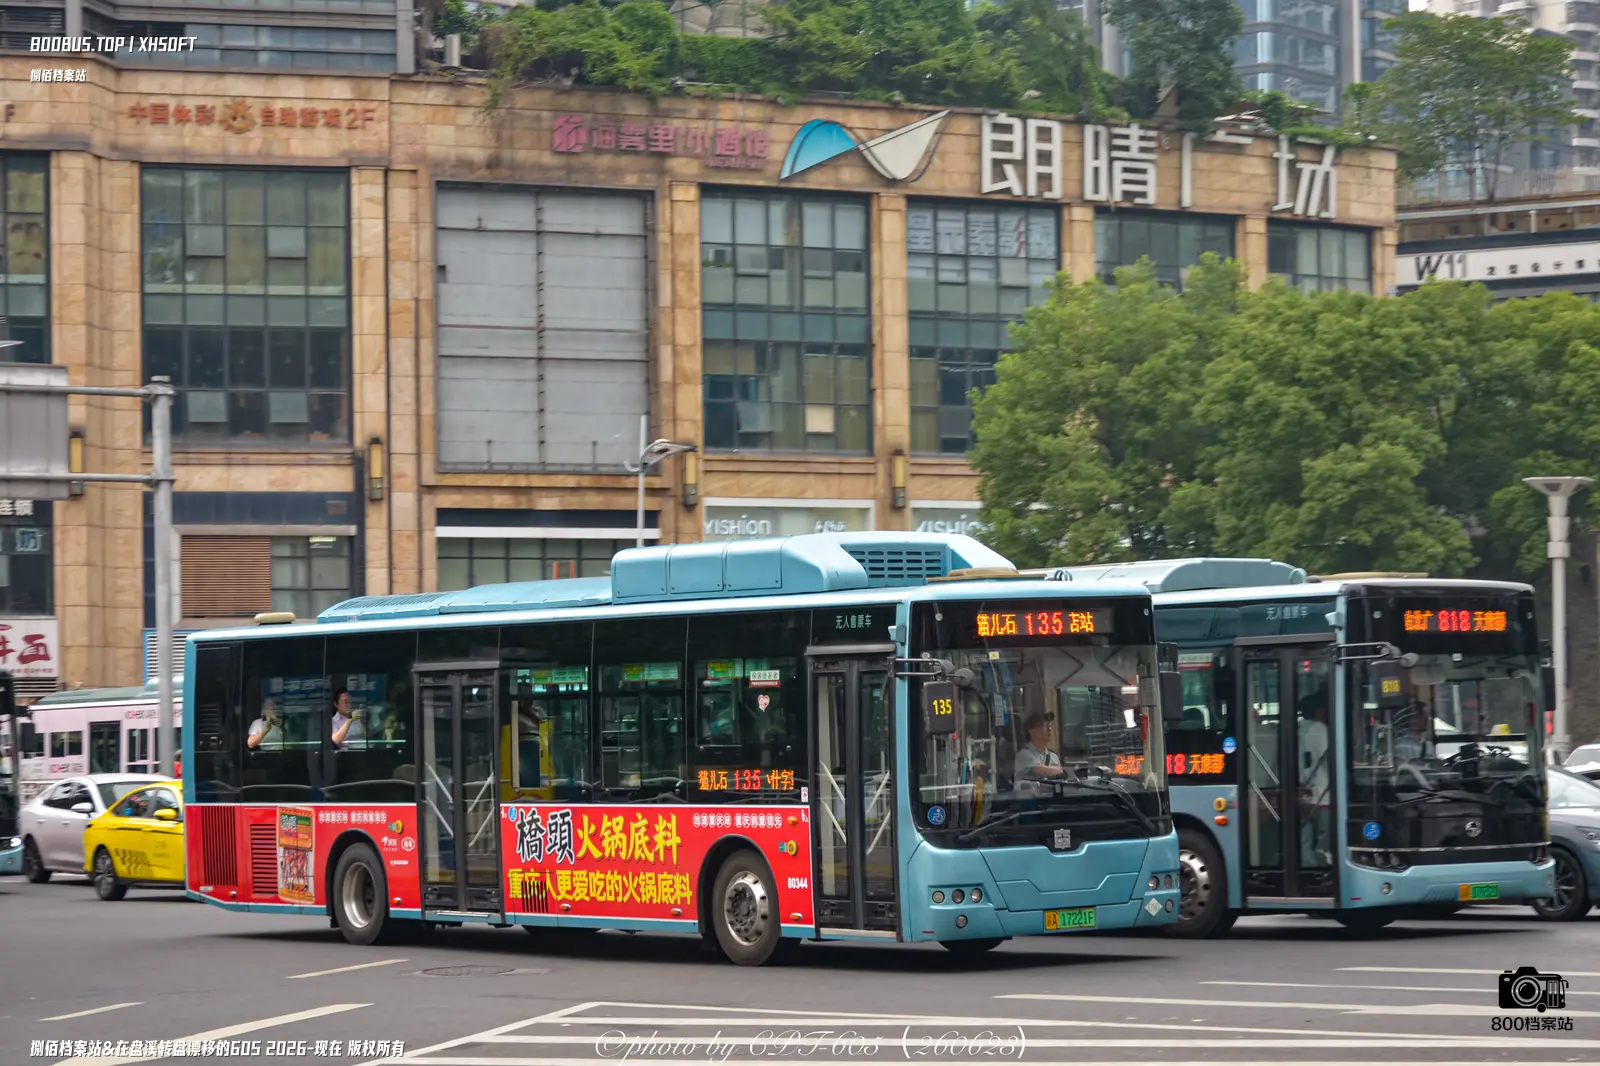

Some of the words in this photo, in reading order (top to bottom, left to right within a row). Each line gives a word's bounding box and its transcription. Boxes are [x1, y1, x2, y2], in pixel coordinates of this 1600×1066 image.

[981, 111, 1338, 220] 朗晴广场
[835, 614, 872, 629] 无人售票车
[1025, 611, 1065, 635] 135
[1438, 609, 1471, 632] 818
[932, 698, 952, 715] 135
[733, 769, 762, 791] 135
[507, 868, 693, 905] 重庆人更爱吃的火锅底料
[787, 877, 808, 889] 80344
